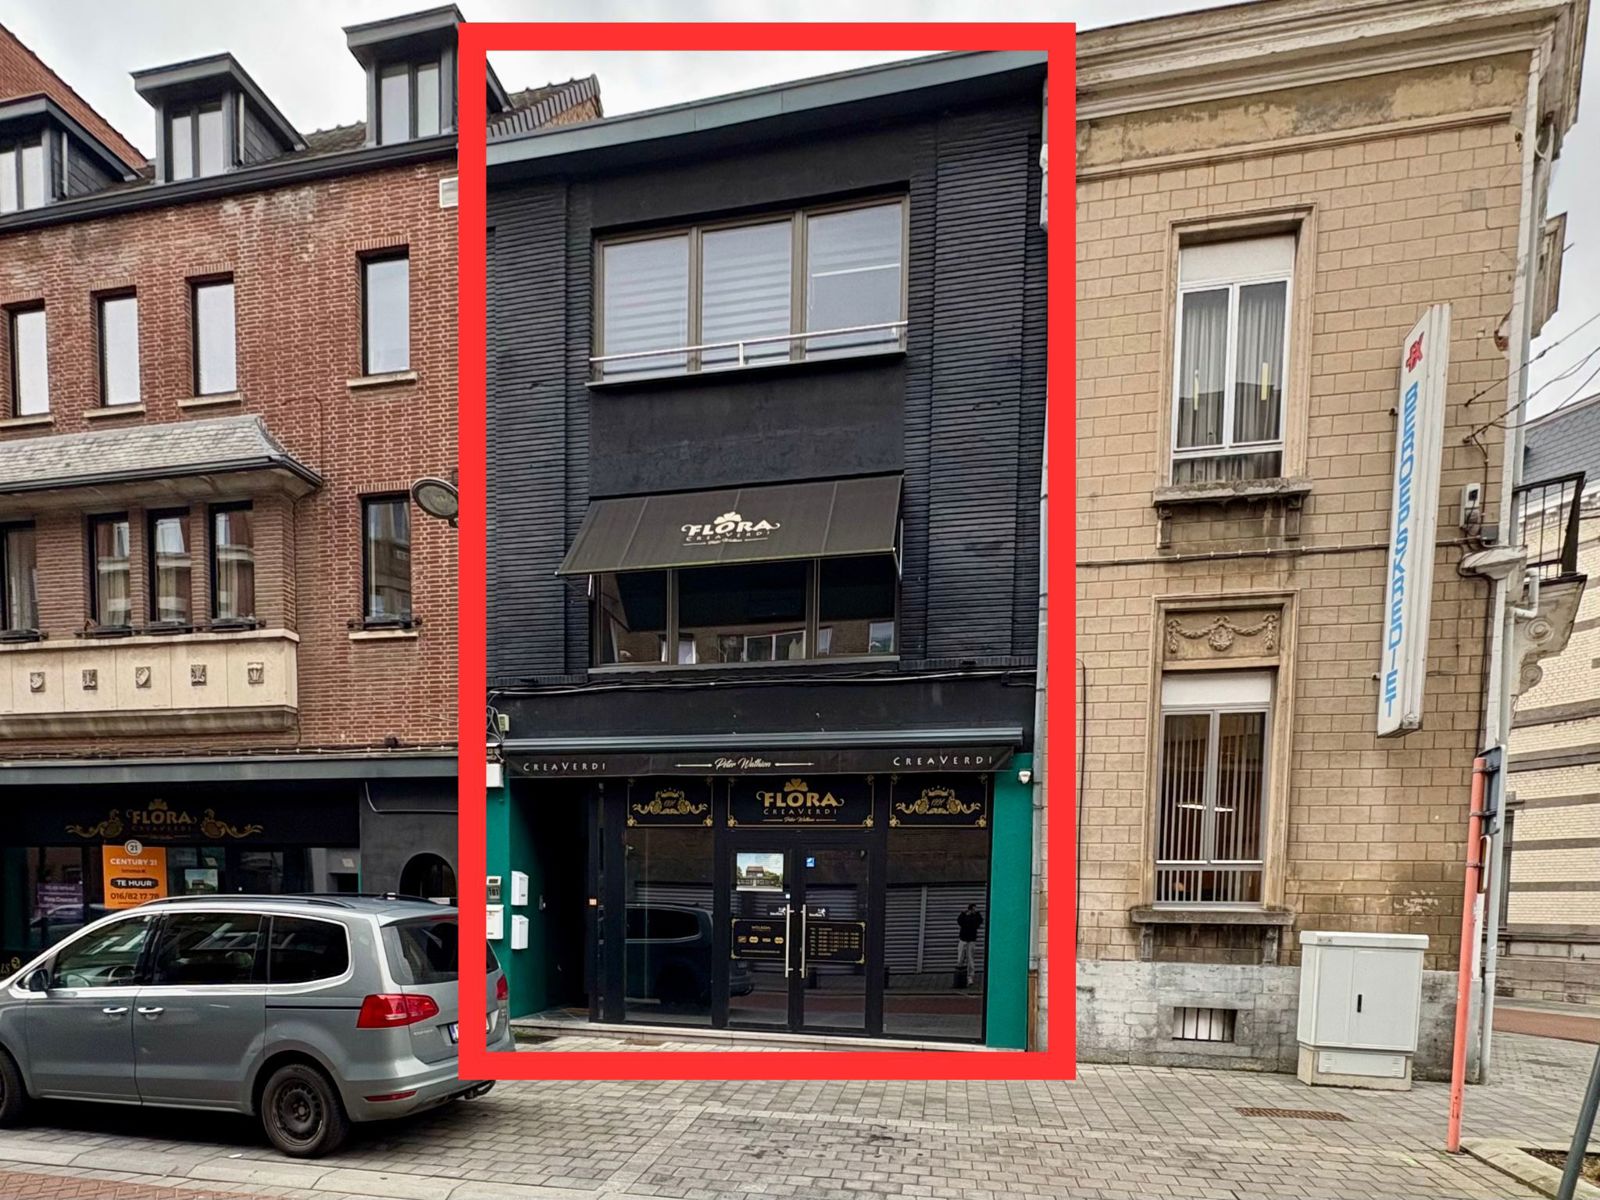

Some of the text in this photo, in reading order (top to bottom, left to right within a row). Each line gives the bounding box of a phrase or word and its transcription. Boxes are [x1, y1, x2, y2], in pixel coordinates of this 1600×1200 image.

[681, 520, 780, 536] FLORA
[1385, 380, 1418, 718] BEROEPSKREDIET
[714, 757, 736, 770] Peter
[893, 755, 993, 766] CREAVERDI
[523, 762, 607, 772] CREAVERDI
[756, 791, 844, 808] FLORA
[126, 809, 198, 825] FLORA
[763, 808, 838, 816] CREAVERDI
[110, 858, 147, 866] CENTURY
[116, 879, 127, 887] TE
[110, 892, 138, 900] 016/82
